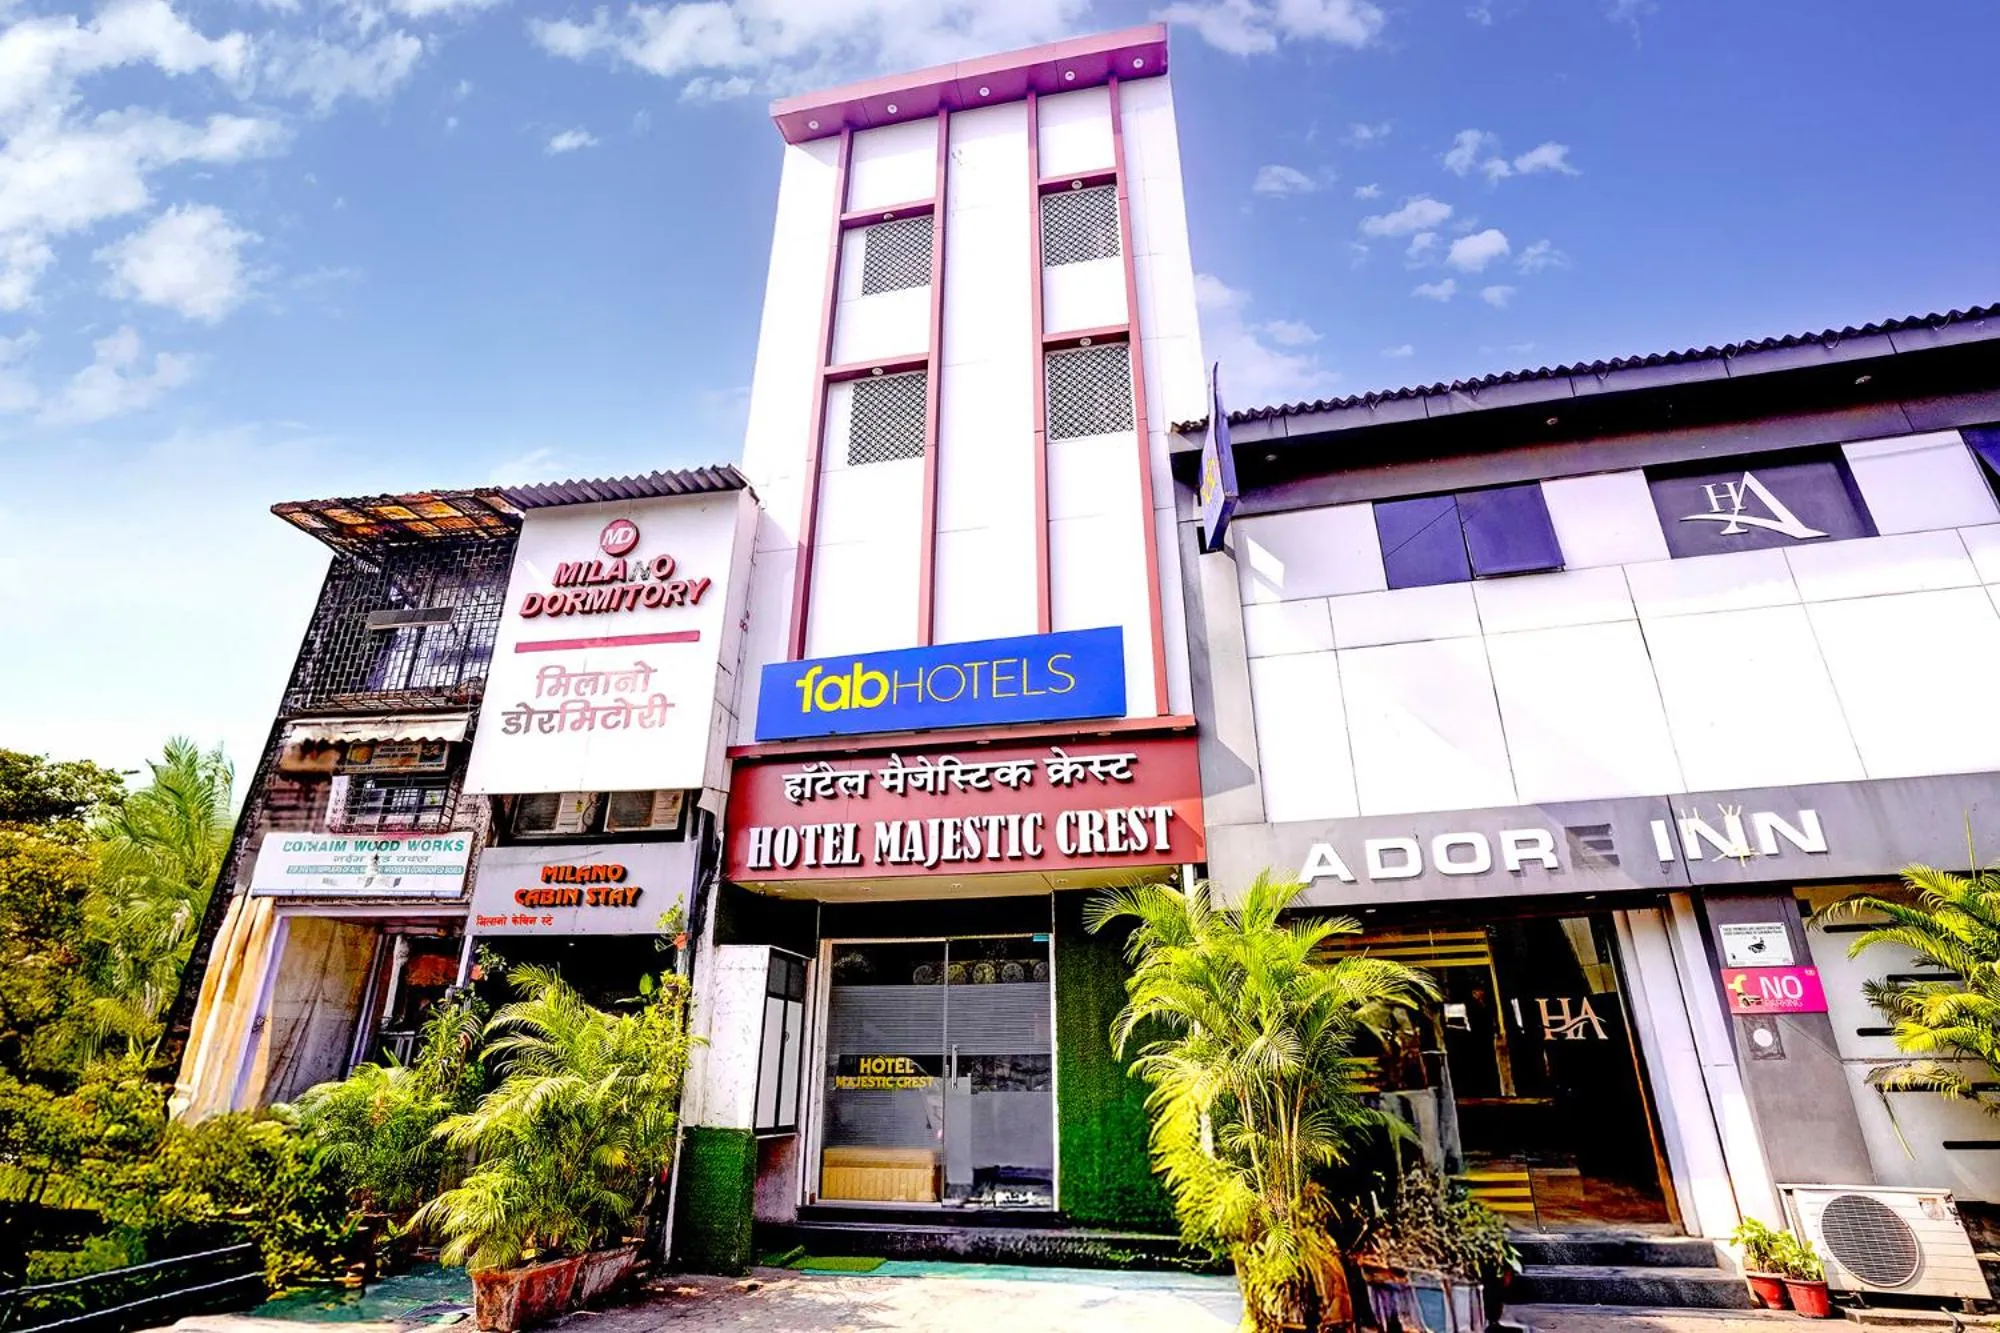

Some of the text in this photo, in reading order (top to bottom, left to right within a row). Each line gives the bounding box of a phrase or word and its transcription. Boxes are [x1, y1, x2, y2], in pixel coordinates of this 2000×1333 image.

[601, 526, 635, 546] MD
[552, 554, 676, 586] MILANO
[519, 577, 712, 618] DORMITORY
[535, 660, 658, 698] मिलानो
[501, 693, 675, 735] डोरमिटोरी
[782, 746, 1138, 803] हॉटेल मैजेस्टिक क्रेस्ट
[354, 840, 401, 852] WOOD
[408, 839, 465, 852] WORKS
[747, 806, 1173, 869] HOTEL MAJESTIC CREST
[1650, 808, 1828, 863] INN
[540, 864, 627, 884] MILANO
[514, 886, 643, 908] CABIN STAY
[1759, 975, 1804, 999] NO
[860, 1057, 914, 1074] HOTEL
[836, 1076, 934, 1089] MAJESTIC CREST
